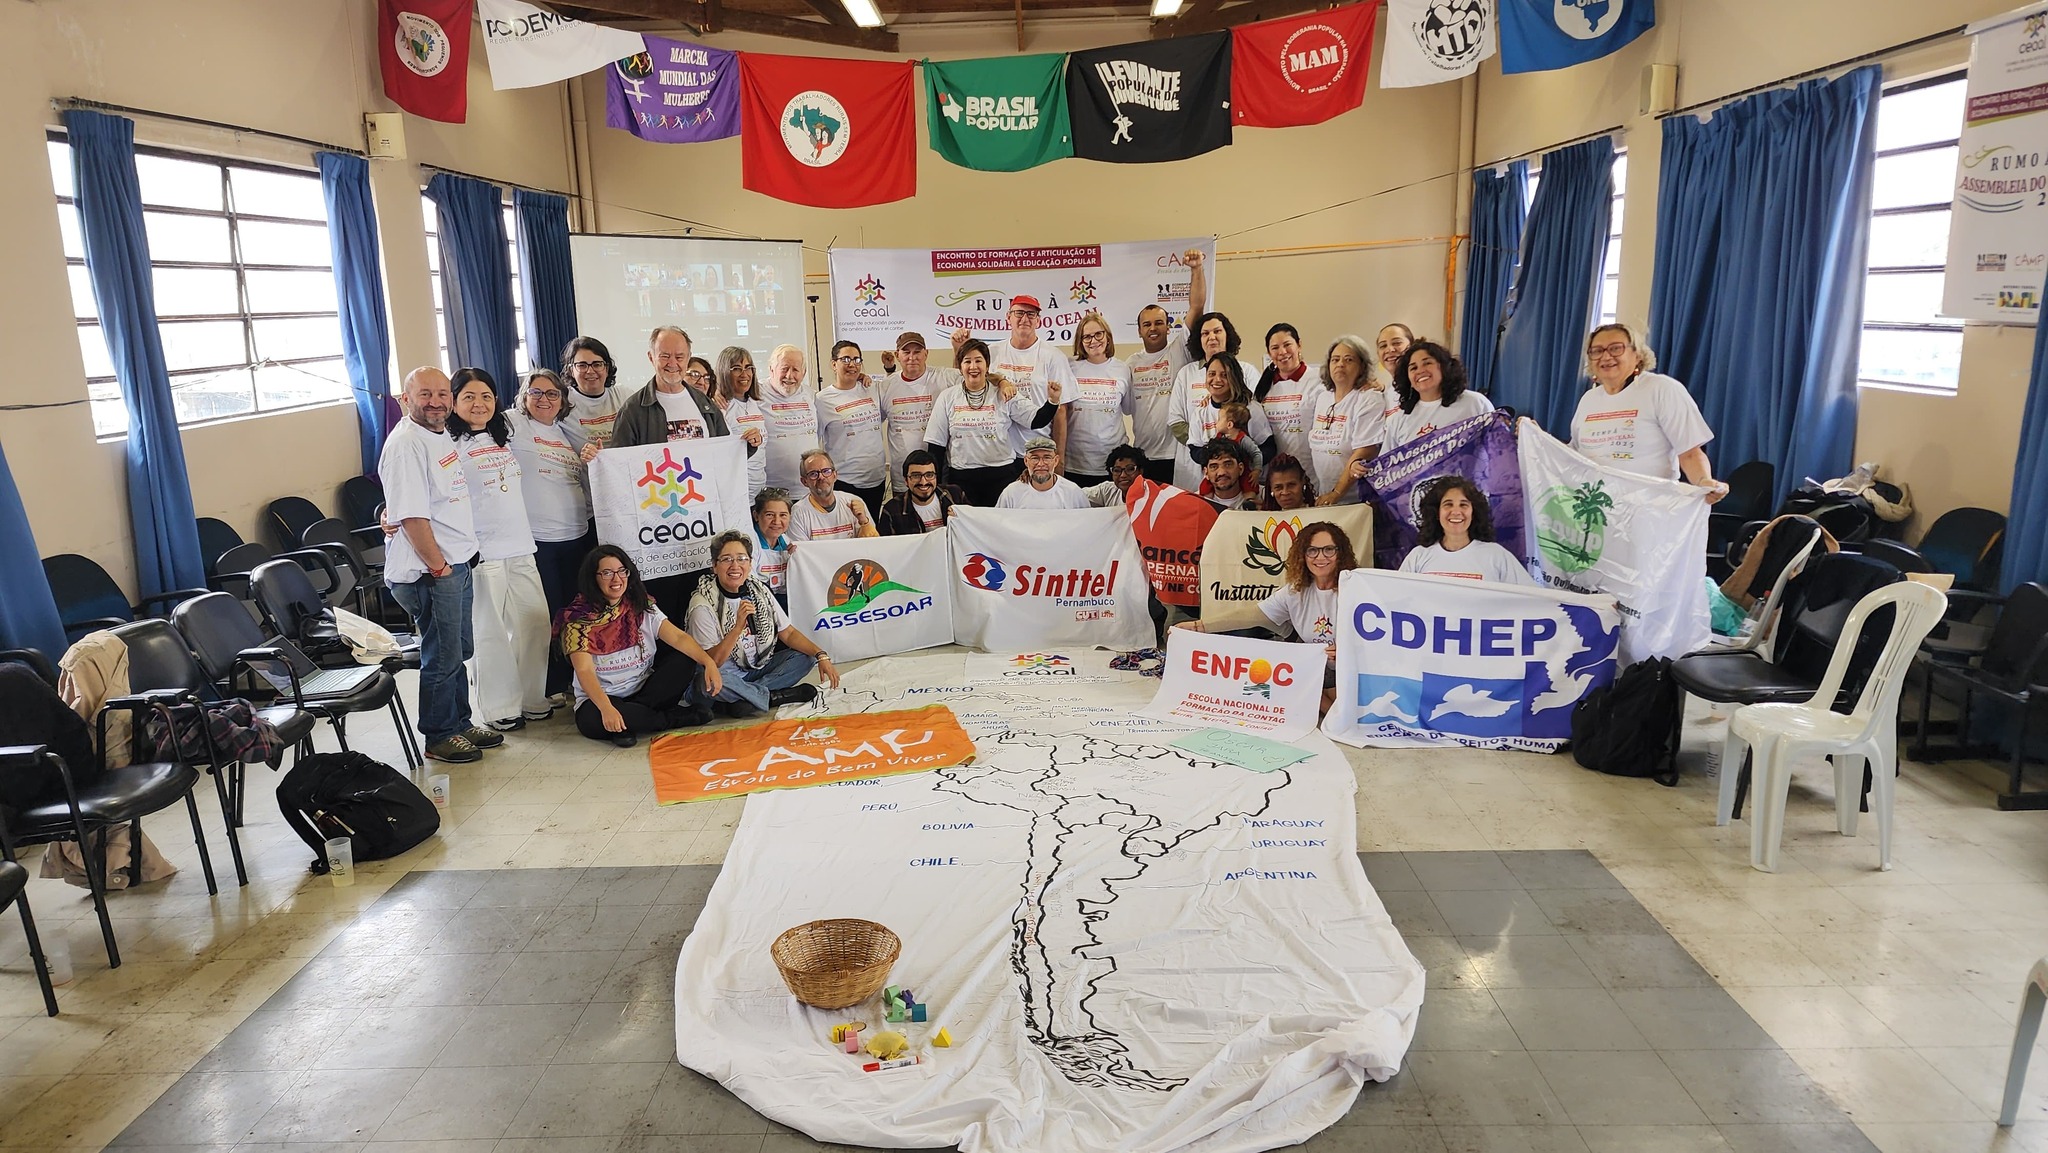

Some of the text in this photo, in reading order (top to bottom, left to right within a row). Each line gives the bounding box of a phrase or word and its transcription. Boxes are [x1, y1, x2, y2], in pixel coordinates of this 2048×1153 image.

[670, 47, 709, 67] MARCHA
[1288, 45, 1339, 73] MAM
[659, 70, 717, 87] MUNDIAL DAS
[1099, 60, 1181, 92] LEVANTE
[966, 96, 1039, 117] BRASIL
[966, 115, 1039, 131] POPULAR
[1990, 152, 2039, 171] RUMO
[1959, 174, 2047, 195] ASSEMBLEIA DO
[936, 252, 976, 260] ENCONTRO
[978, 251, 987, 259] DE
[988, 249, 1029, 259] FORMAÇÃO
[1036, 248, 1085, 258] ARTICULAÇÃO
[1087, 247, 1096, 255] DE
[977, 259, 1015, 268] SOLIDÁRIA
[1022, 258, 1061, 268] EDUCAÇÃO
[1062, 257, 1097, 265] POPULAR
[853, 305, 890, 318] ceaal
[935, 313, 1012, 331] ASSEMBLE
[1046, 330, 1072, 341] 20
[638, 511, 716, 546] ceaal
[646, 546, 712, 562] de educación
[669, 561, 696, 573] latina
[697, 560, 704, 568] y
[1012, 560, 1120, 597] Sinttel
[1210, 580, 1279, 602] Institut
[1055, 597, 1115, 607] Pernambuco
[813, 595, 933, 632] ASSESOAR
[1353, 602, 1557, 657] CDHEP
[595, 664, 630, 672] ASSEMBLEIA
[1003, 667, 1076, 677] ceaal
[1190, 650, 1294, 687] ENFOC
[1187, 692, 1286, 715] ESCOLA NACIONAL DE
[1231, 710, 1245, 718] DA
[1246, 713, 1286, 725] CONTAG
[703, 752, 948, 792] Escola do Bem Viver
[921, 822, 974, 831] BOLIVIA
[1251, 839, 1328, 849] URUGUAY
[909, 857, 959, 867] CHILE
[1224, 867, 1318, 881] ARGENTINA
